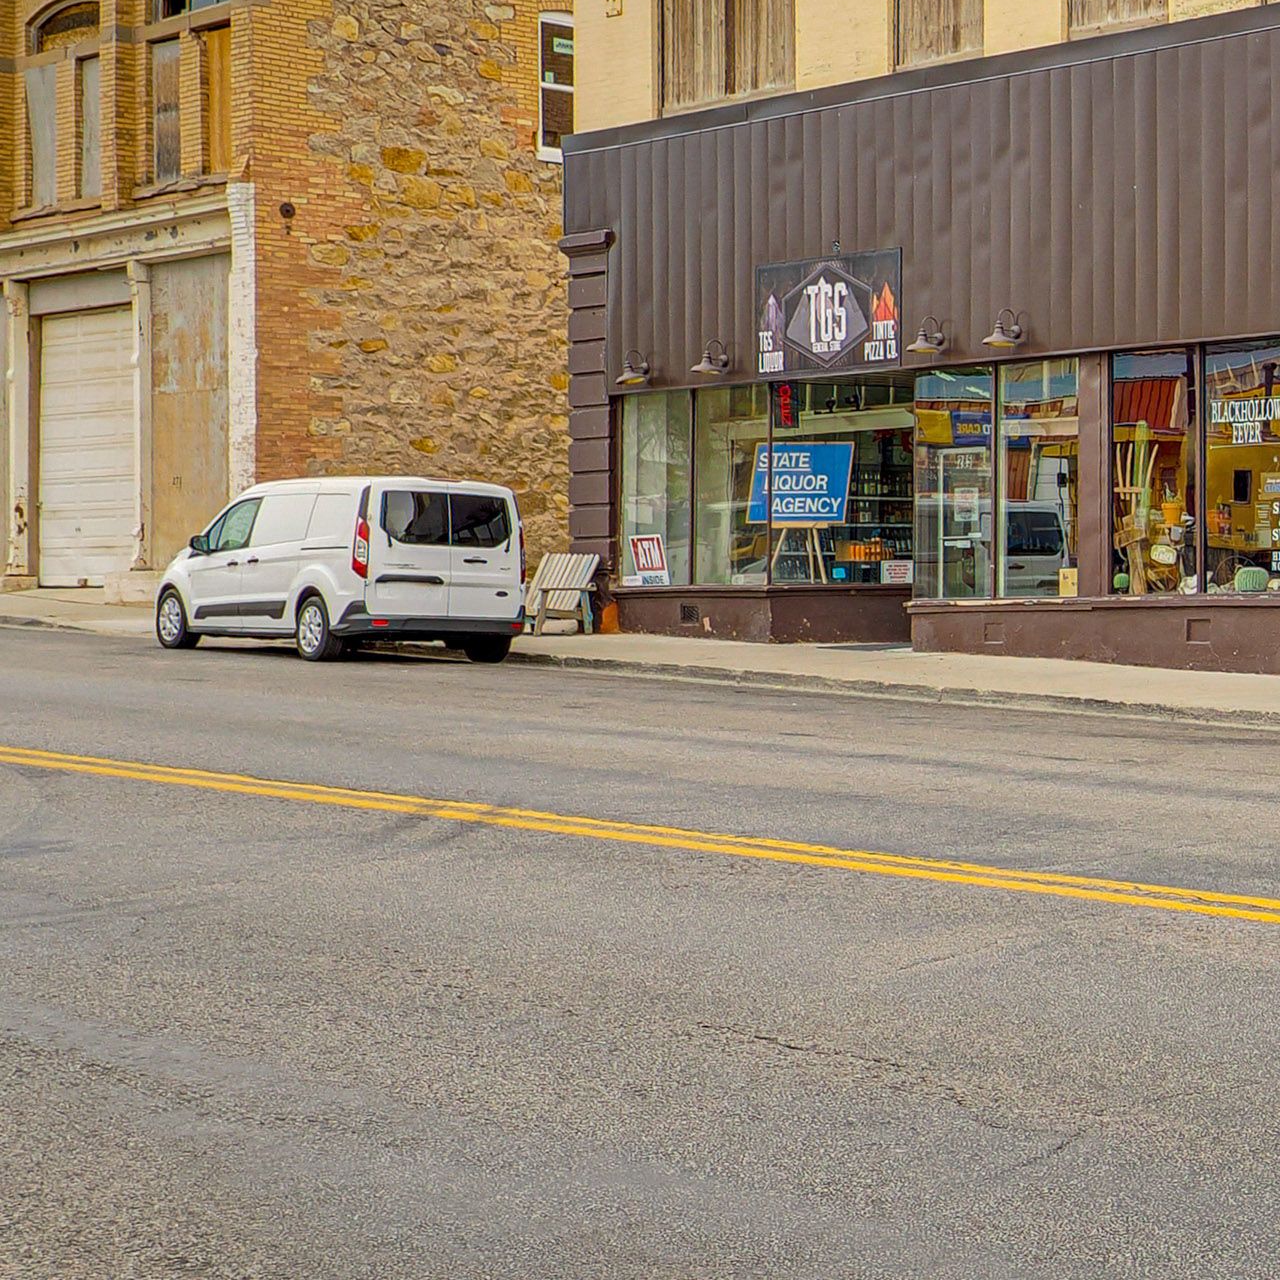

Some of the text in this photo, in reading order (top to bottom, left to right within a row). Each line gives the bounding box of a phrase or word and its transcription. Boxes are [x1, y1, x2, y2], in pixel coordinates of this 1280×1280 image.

[806, 277, 847, 342] TGS
[759, 330, 773, 352] TGS
[864, 339, 898, 361] PIZZA CO.
[758, 350, 784, 374] LIQUOR
[1232, 422, 1262, 444] FEVER
[759, 452, 811, 468] STATE
[763, 474, 828, 491] LIQUOR
[772, 497, 841, 513] AGENCY
[636, 537, 665, 569] ATM
